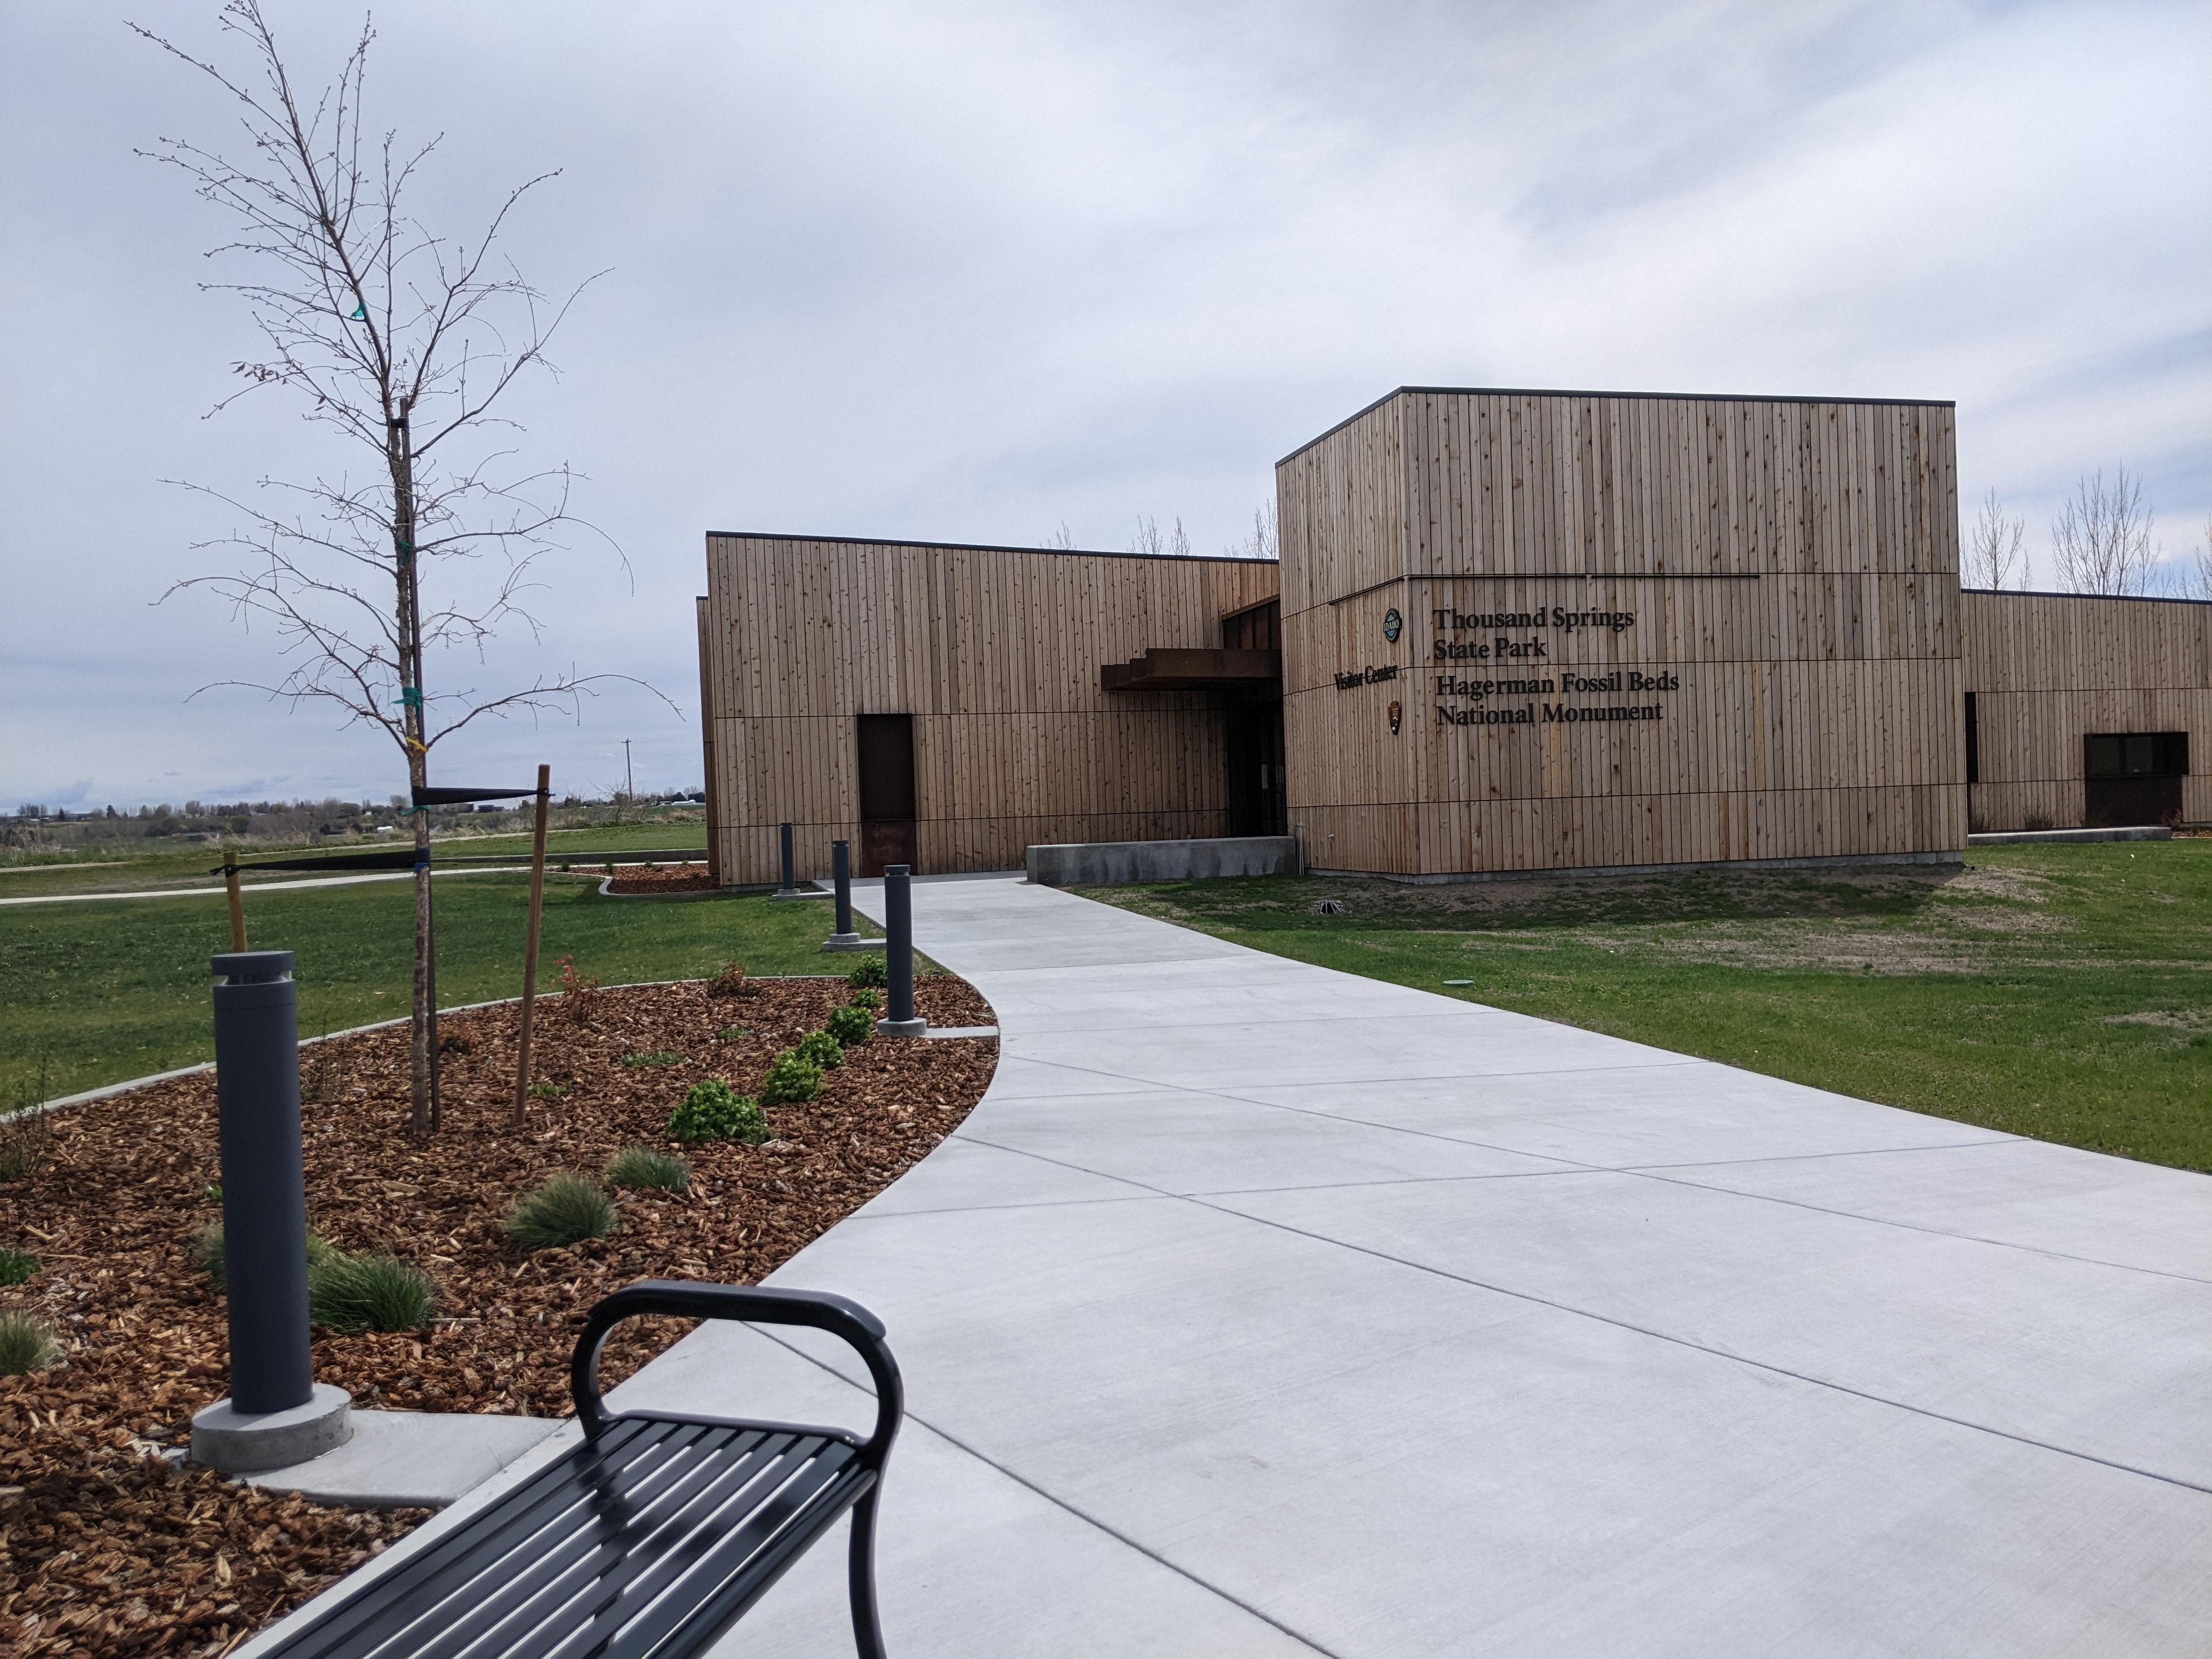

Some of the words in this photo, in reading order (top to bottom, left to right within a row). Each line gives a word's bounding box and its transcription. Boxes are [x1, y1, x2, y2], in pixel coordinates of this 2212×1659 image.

[1383, 619, 1399, 632] IDAHO
[1433, 607, 1547, 629] Thousand
[1553, 607, 1634, 632] Springs
[1434, 639, 1490, 659] State
[1495, 636, 1547, 657] Park
[1334, 671, 1363, 690] Visitor
[1365, 664, 1398, 684] Center
[1436, 675, 1555, 701] Hagerman
[1561, 672, 1622, 692] Fossil
[1628, 670, 1679, 691] Beds
[1437, 703, 1535, 725] National
[1542, 703, 1663, 723] Monument
